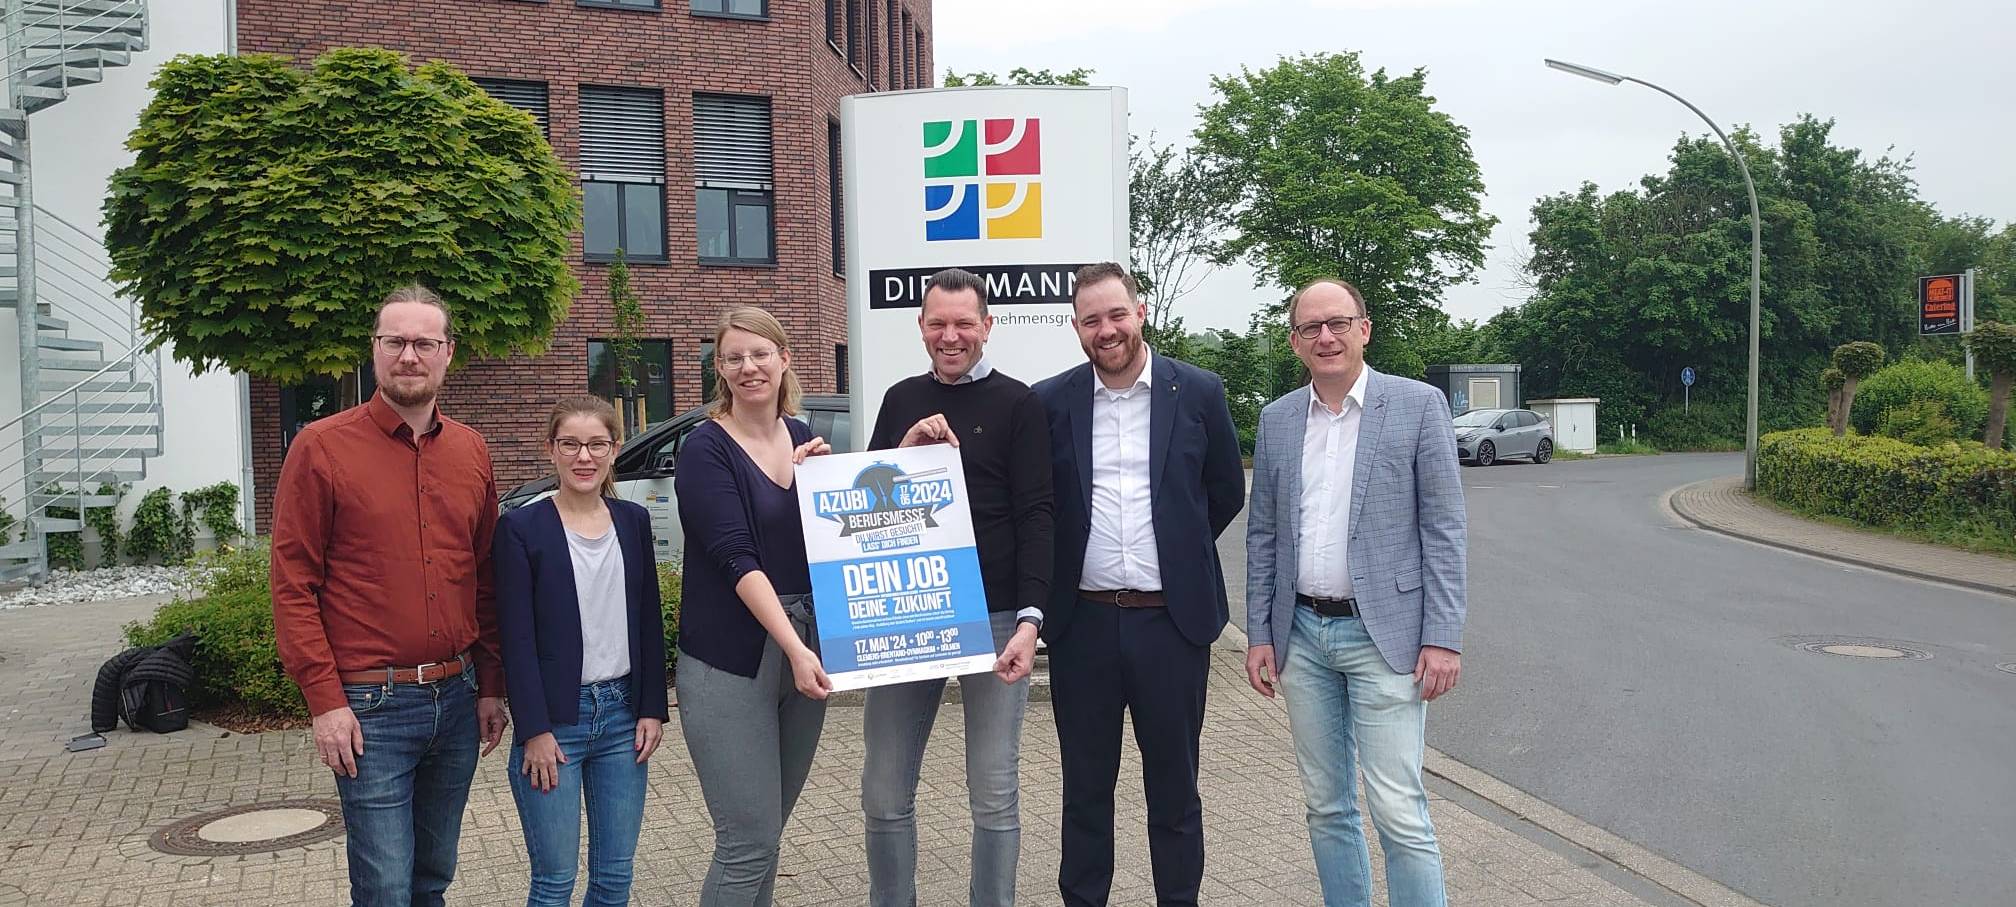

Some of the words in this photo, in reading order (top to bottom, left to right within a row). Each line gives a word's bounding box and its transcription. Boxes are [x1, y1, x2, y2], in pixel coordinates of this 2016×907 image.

[899, 484, 908, 494] 17
[910, 480, 953, 505] 2024
[819, 488, 868, 513] AZUBI
[849, 507, 926, 529] BERUFSMESSE
[866, 529, 889, 542] WIRST
[881, 539, 896, 549] DICH
[842, 559, 902, 597] DEIN
[906, 555, 949, 591] JOB
[848, 598, 888, 620] DEINE
[892, 591, 952, 615] ZUKUNFT
[854, 639, 868, 654] 17.
[869, 636, 889, 653] MAI
[890, 634, 907, 650] '24
